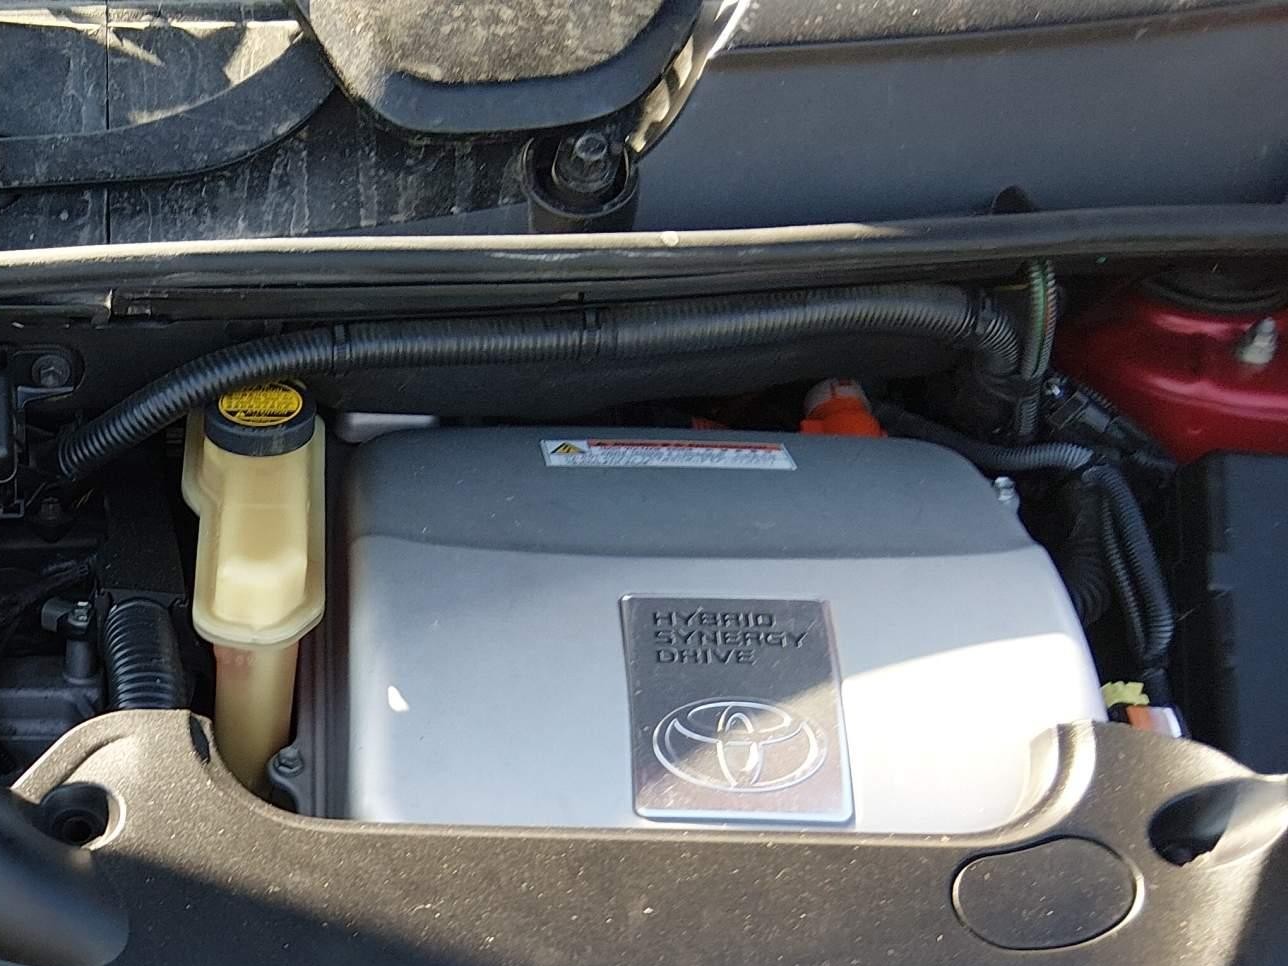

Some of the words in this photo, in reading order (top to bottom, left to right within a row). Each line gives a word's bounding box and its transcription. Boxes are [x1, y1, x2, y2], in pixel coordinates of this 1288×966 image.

[654, 610, 776, 627] HYBRID
[655, 629, 809, 648] SYNERGY
[657, 649, 759, 666] DRIVE
